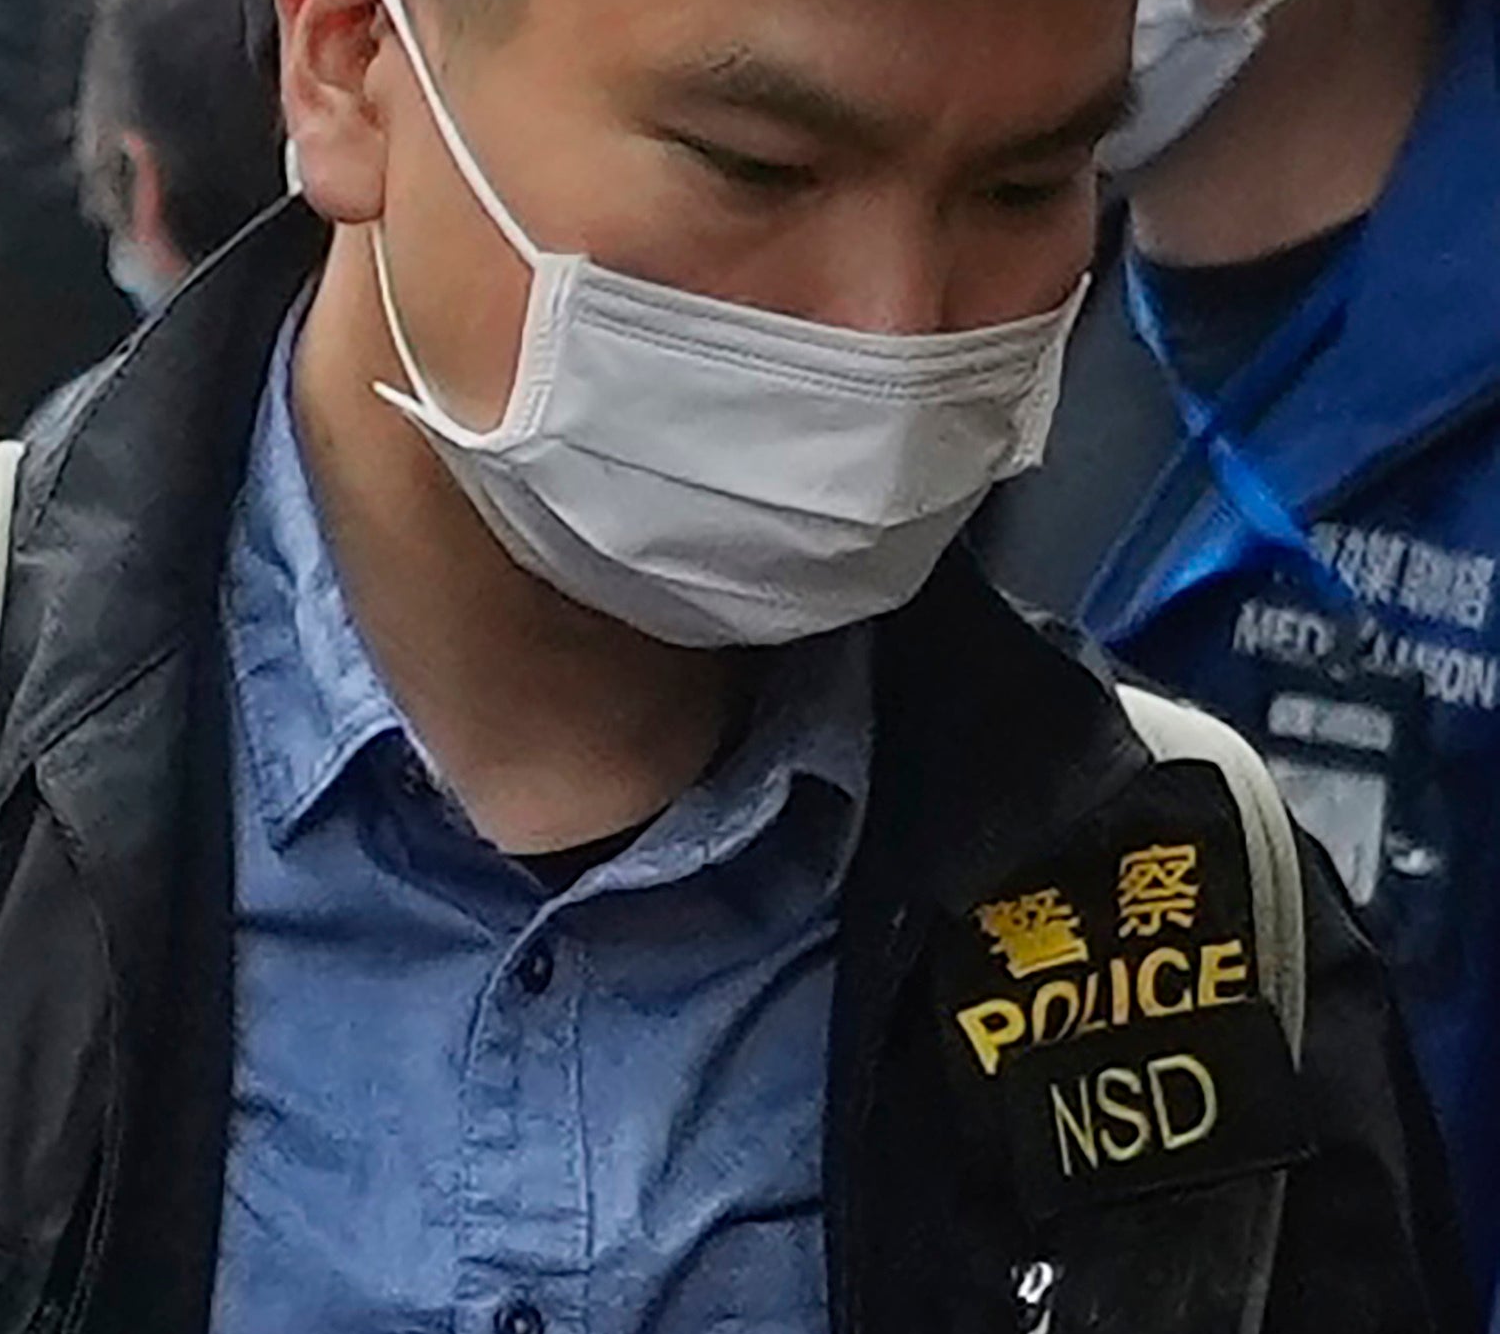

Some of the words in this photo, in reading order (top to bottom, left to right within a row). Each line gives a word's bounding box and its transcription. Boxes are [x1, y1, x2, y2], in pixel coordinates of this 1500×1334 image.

[973, 843, 1200, 979] 警察
[957, 940, 1248, 1074] POLICE
[1050, 1055, 1217, 1175] NSD
